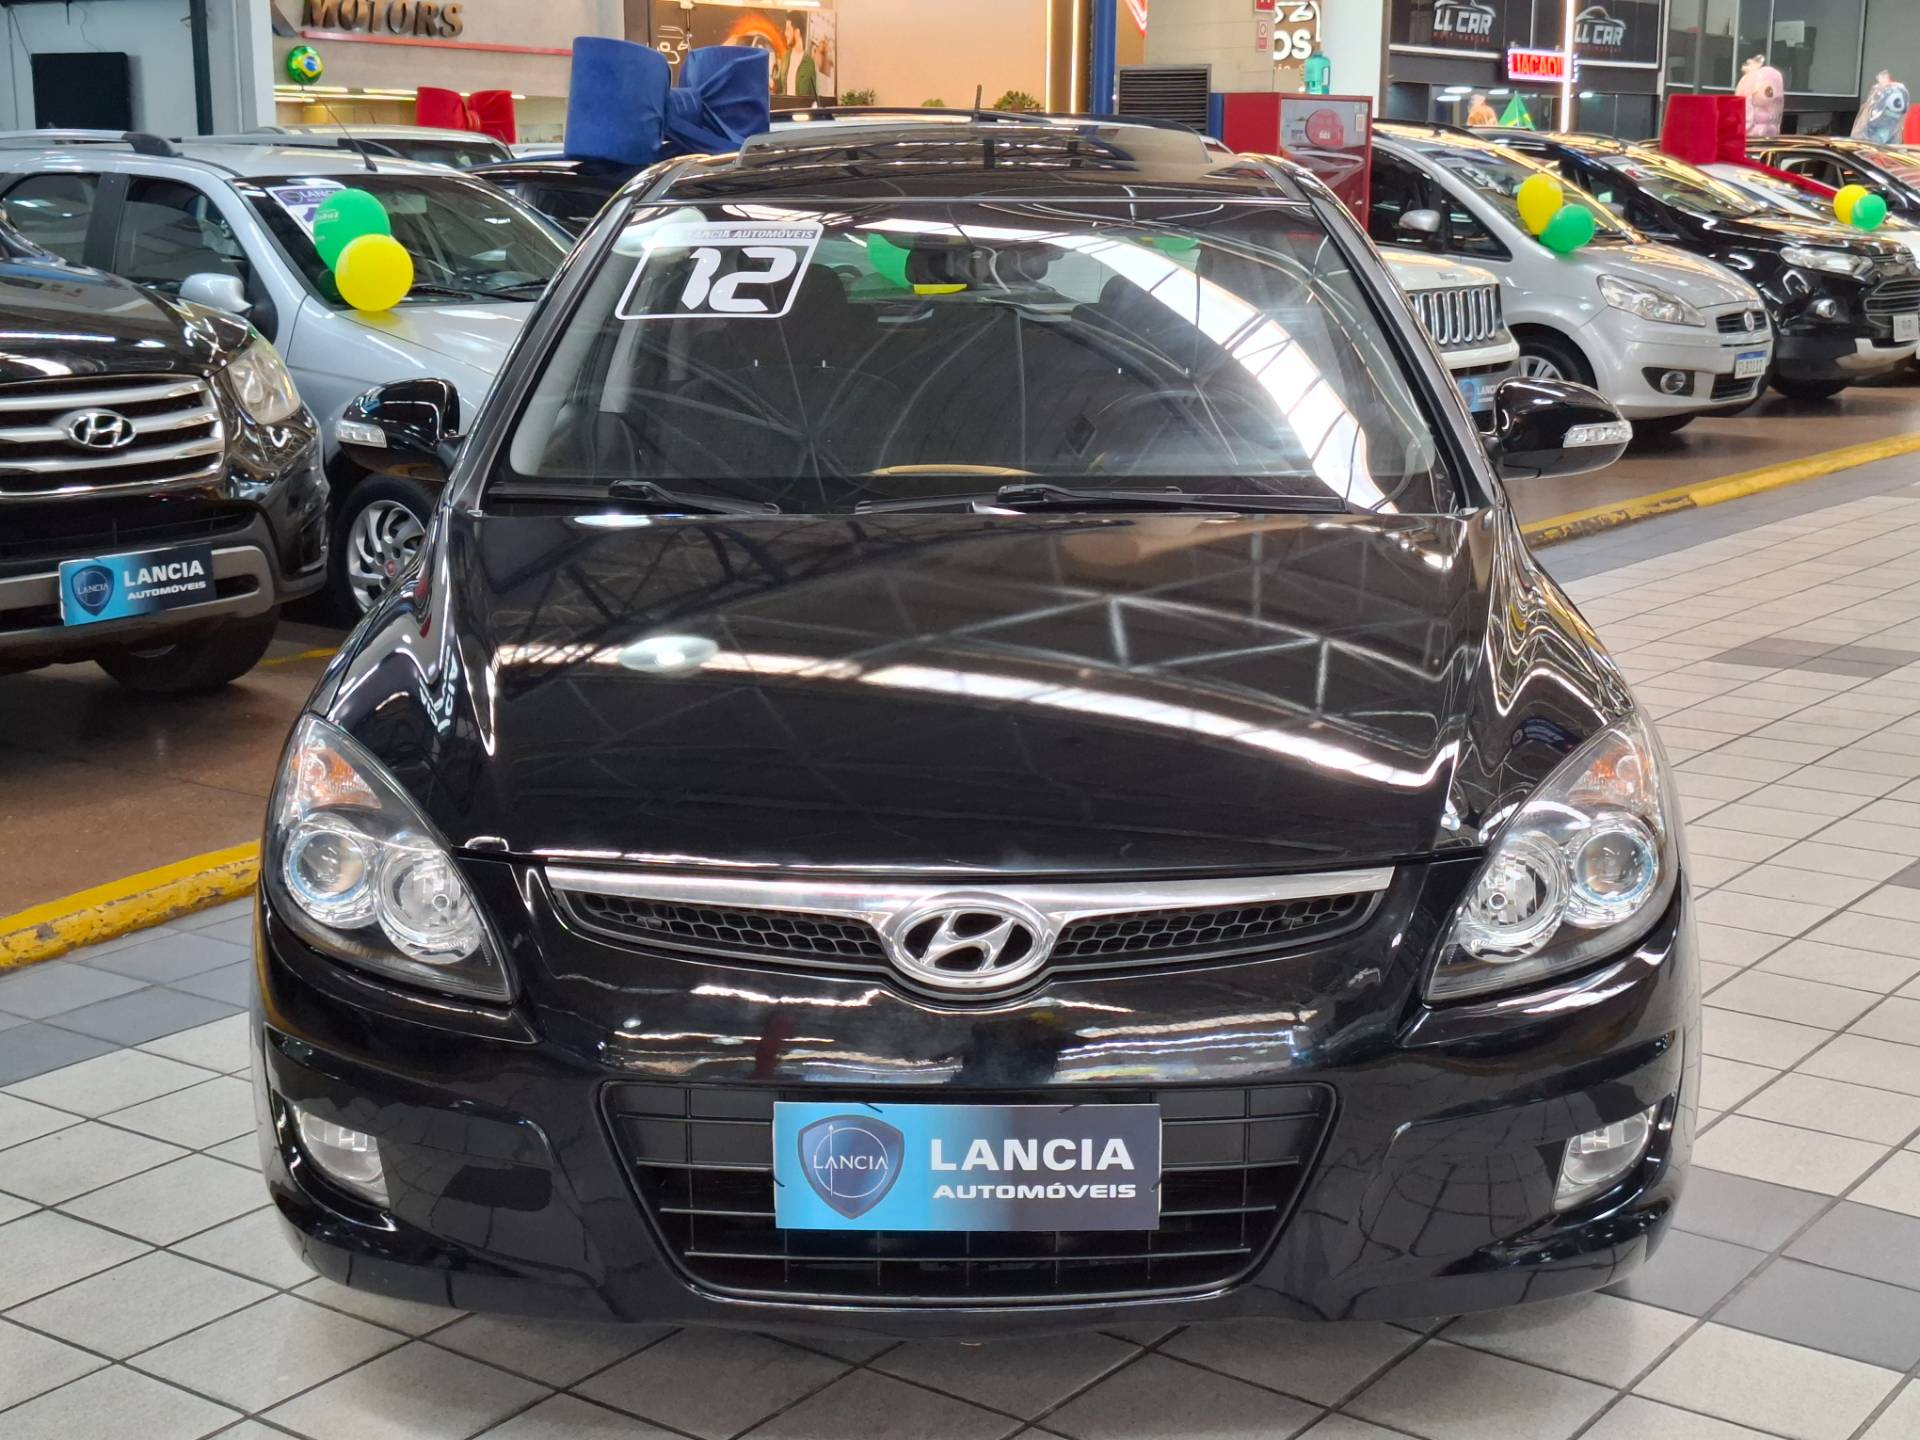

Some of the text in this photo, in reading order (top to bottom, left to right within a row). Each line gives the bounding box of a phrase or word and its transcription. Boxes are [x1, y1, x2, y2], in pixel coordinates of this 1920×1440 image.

[301, 0, 464, 38] MOTORS
[1433, 10, 1493, 35] LL CAR
[1592, 25, 1624, 46] CAR
[681, 247, 797, 312] 12
[123, 560, 205, 587] LANCIA
[77, 583, 110, 595] LANCIA
[127, 581, 207, 600] AUTOMÓVEIS
[812, 1154, 889, 1171] LANCIA
[930, 1138, 1135, 1171] LANCIA
[932, 1182, 1137, 1199] AUTOMÓVEIS
